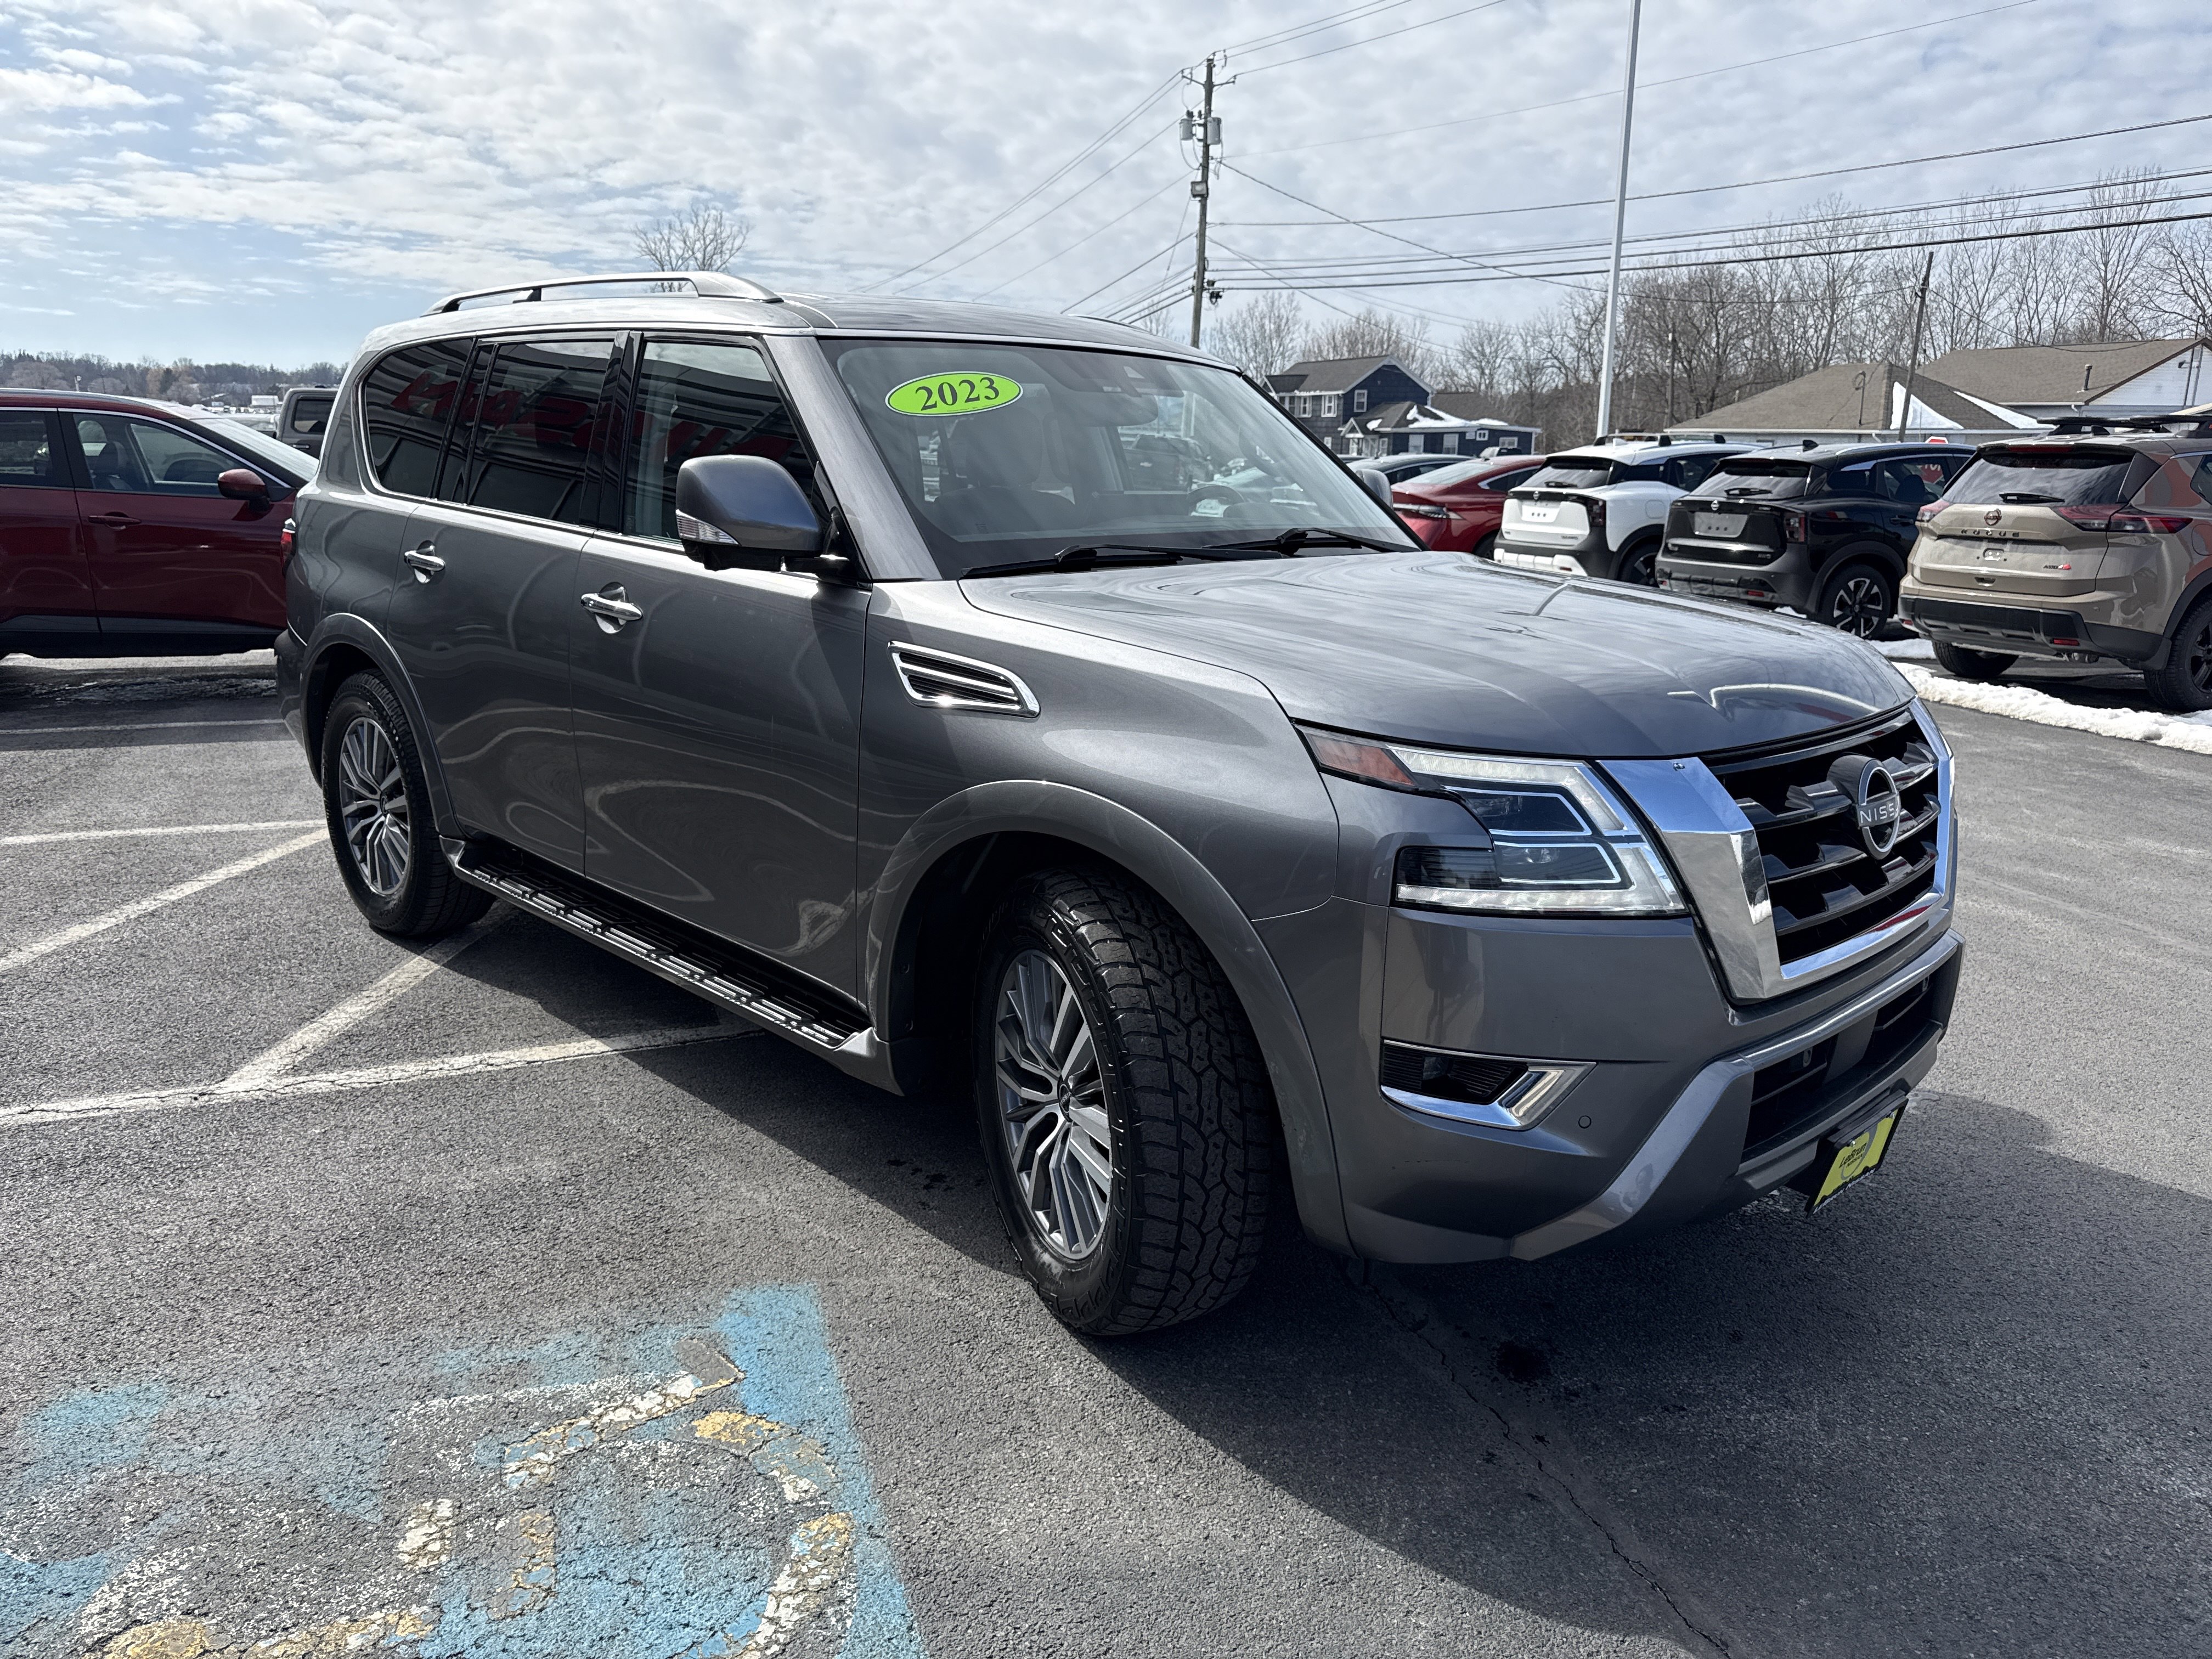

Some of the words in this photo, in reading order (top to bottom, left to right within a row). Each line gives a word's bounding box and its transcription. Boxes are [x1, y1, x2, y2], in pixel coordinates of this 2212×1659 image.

[915, 377, 1000, 411] 2023
[1860, 803, 1899, 824] NISS
[1838, 1142, 1867, 1168] LeBrun
